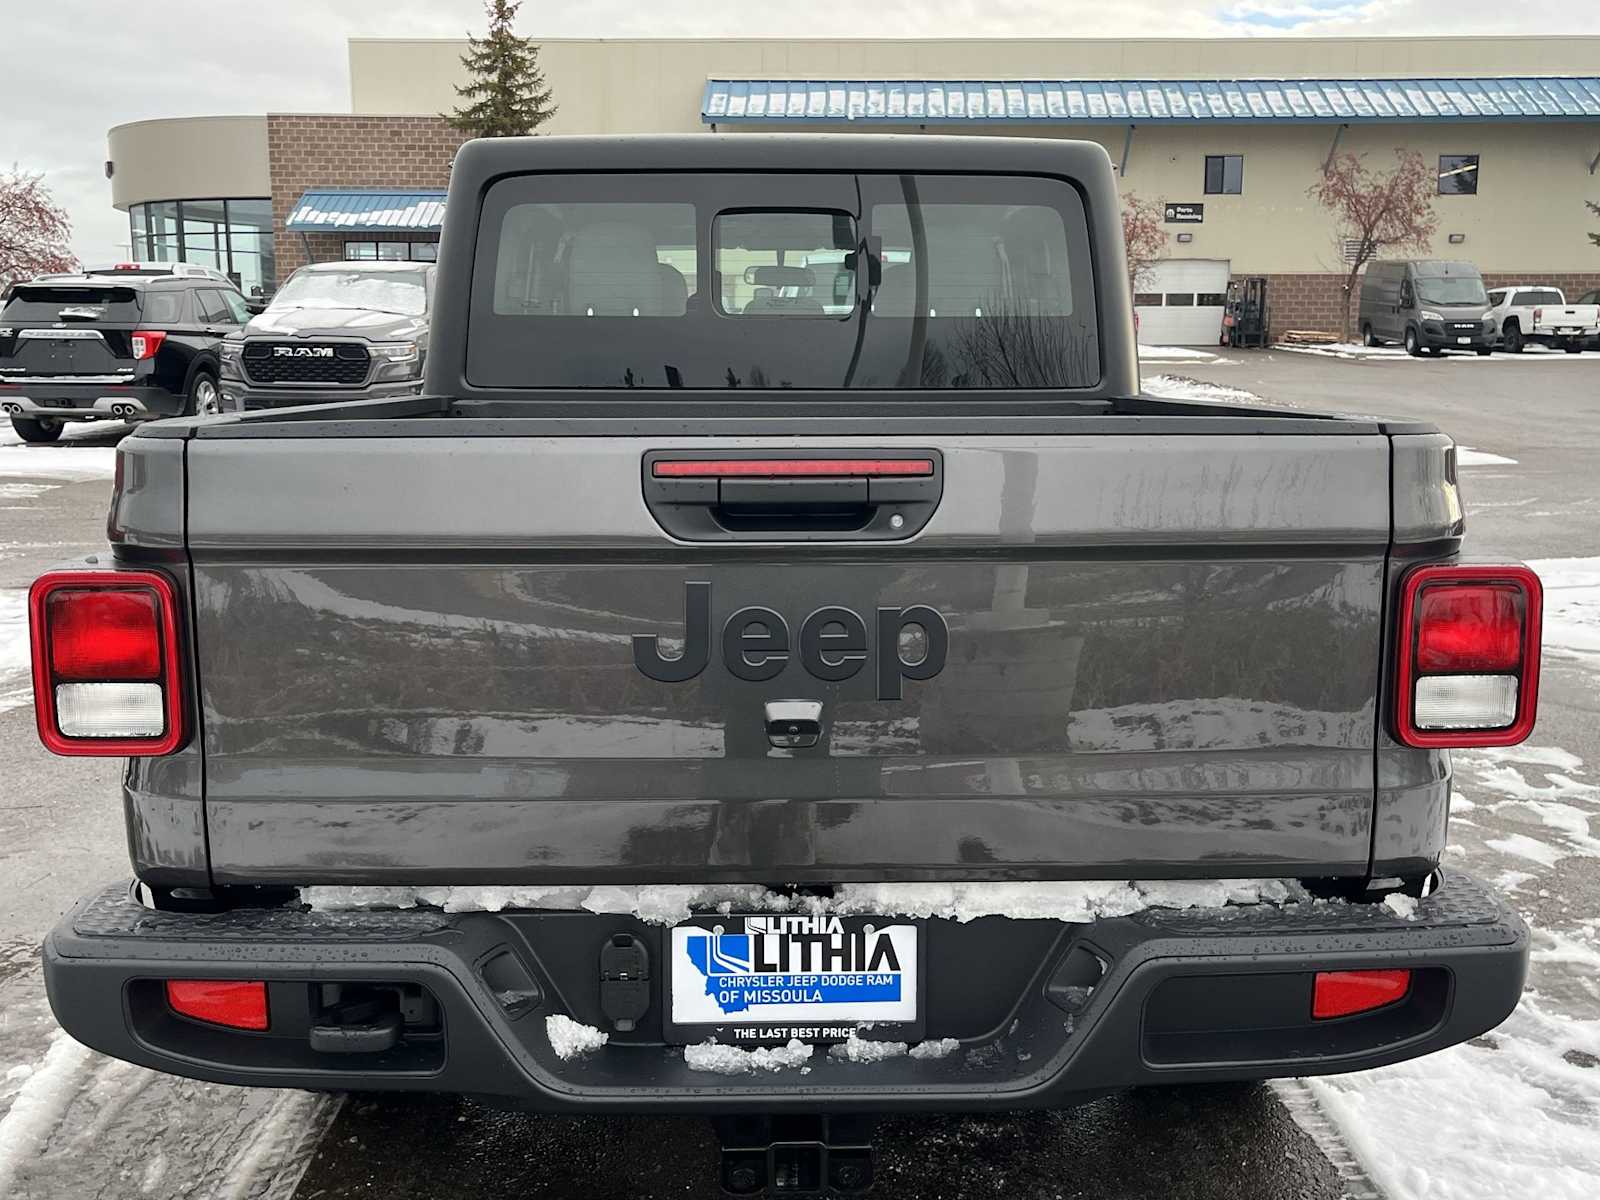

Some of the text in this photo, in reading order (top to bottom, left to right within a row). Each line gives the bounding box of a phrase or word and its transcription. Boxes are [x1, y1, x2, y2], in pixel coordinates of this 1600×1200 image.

[273, 347, 334, 357] RAM
[632, 580, 950, 702] Jeep
[767, 917, 845, 934] LITHIA
[754, 934, 901, 972] LITHIA
[719, 975, 893, 988] CHRYSLER JEEP DODGE RAM
[719, 990, 823, 1003] OF MISSOULA
[734, 1027, 857, 1039] THE LAST BEST PRICE
